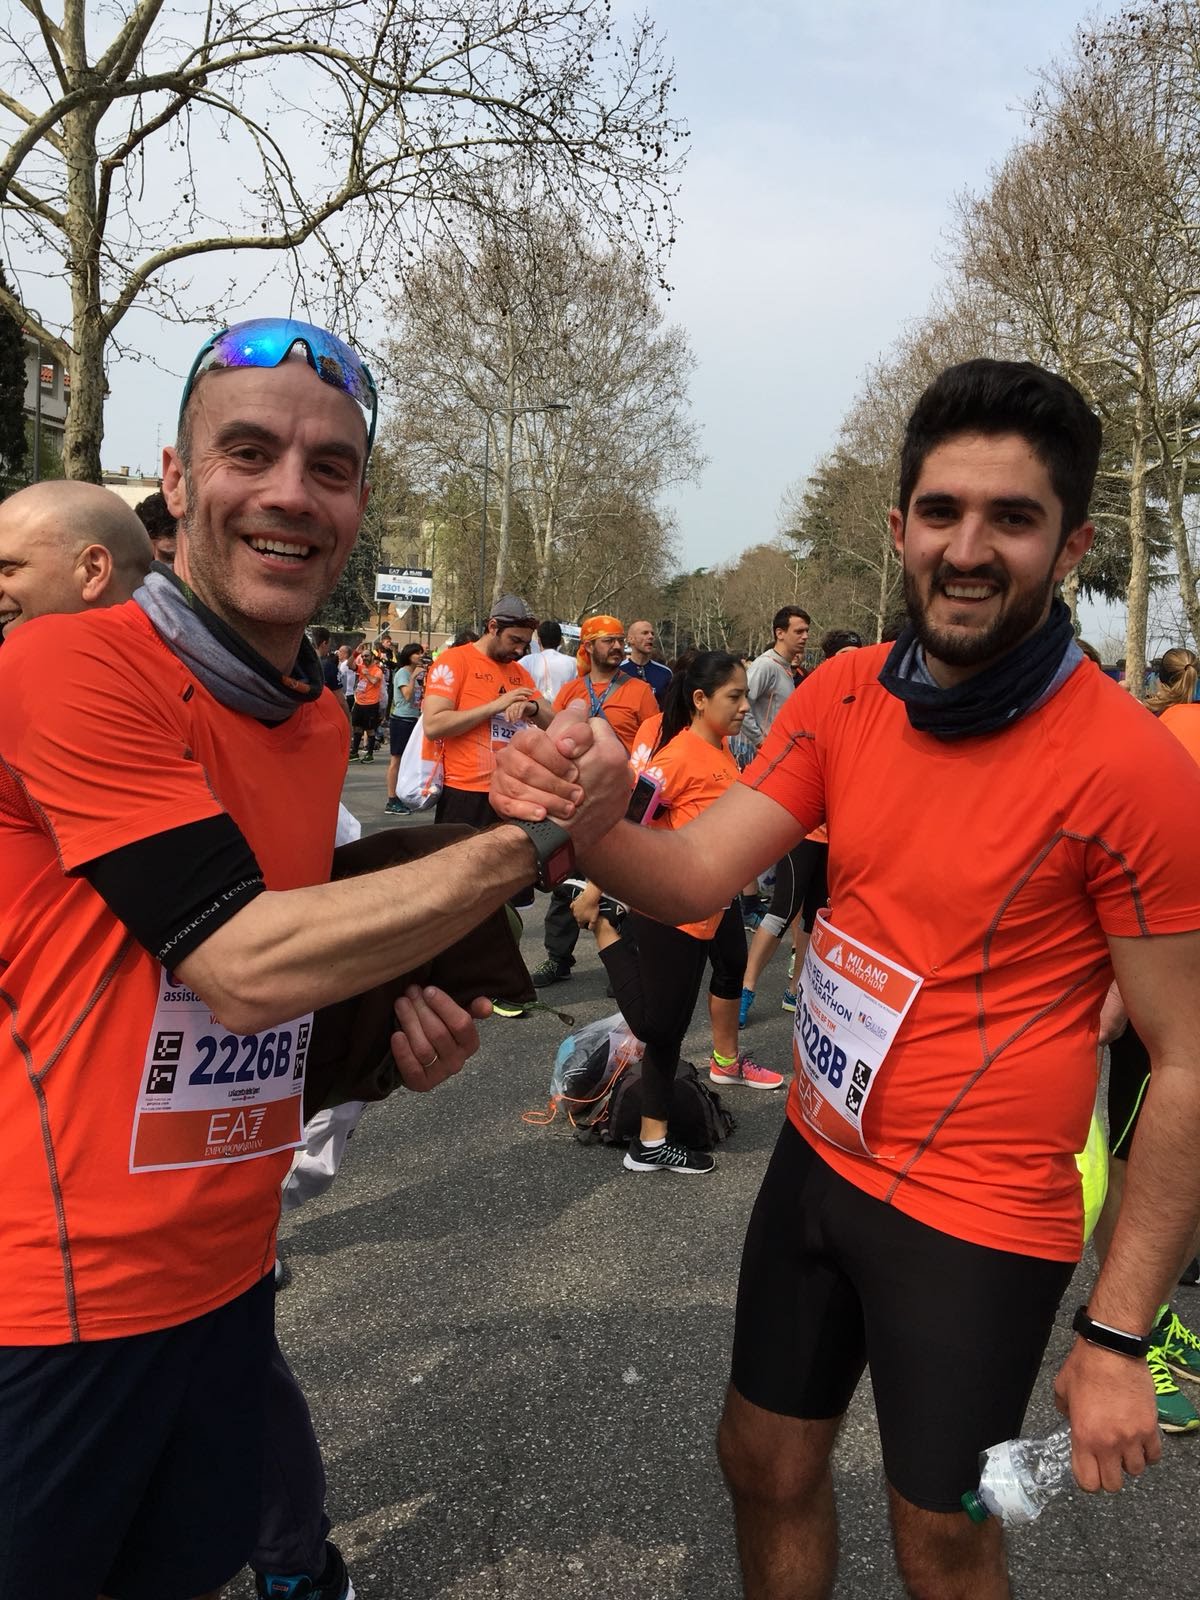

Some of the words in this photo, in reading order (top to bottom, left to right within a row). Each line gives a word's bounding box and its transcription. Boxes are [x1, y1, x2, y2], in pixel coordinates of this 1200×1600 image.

[381, 583, 400, 592] 2301
[408, 586, 430, 595] 2400
[844, 963, 885, 992] MARATHON
[846, 952, 888, 985] MILANO
[188, 1031, 293, 1086] 2226B
[799, 1069, 824, 1118] EA7
[207, 1107, 267, 1145] EA7
